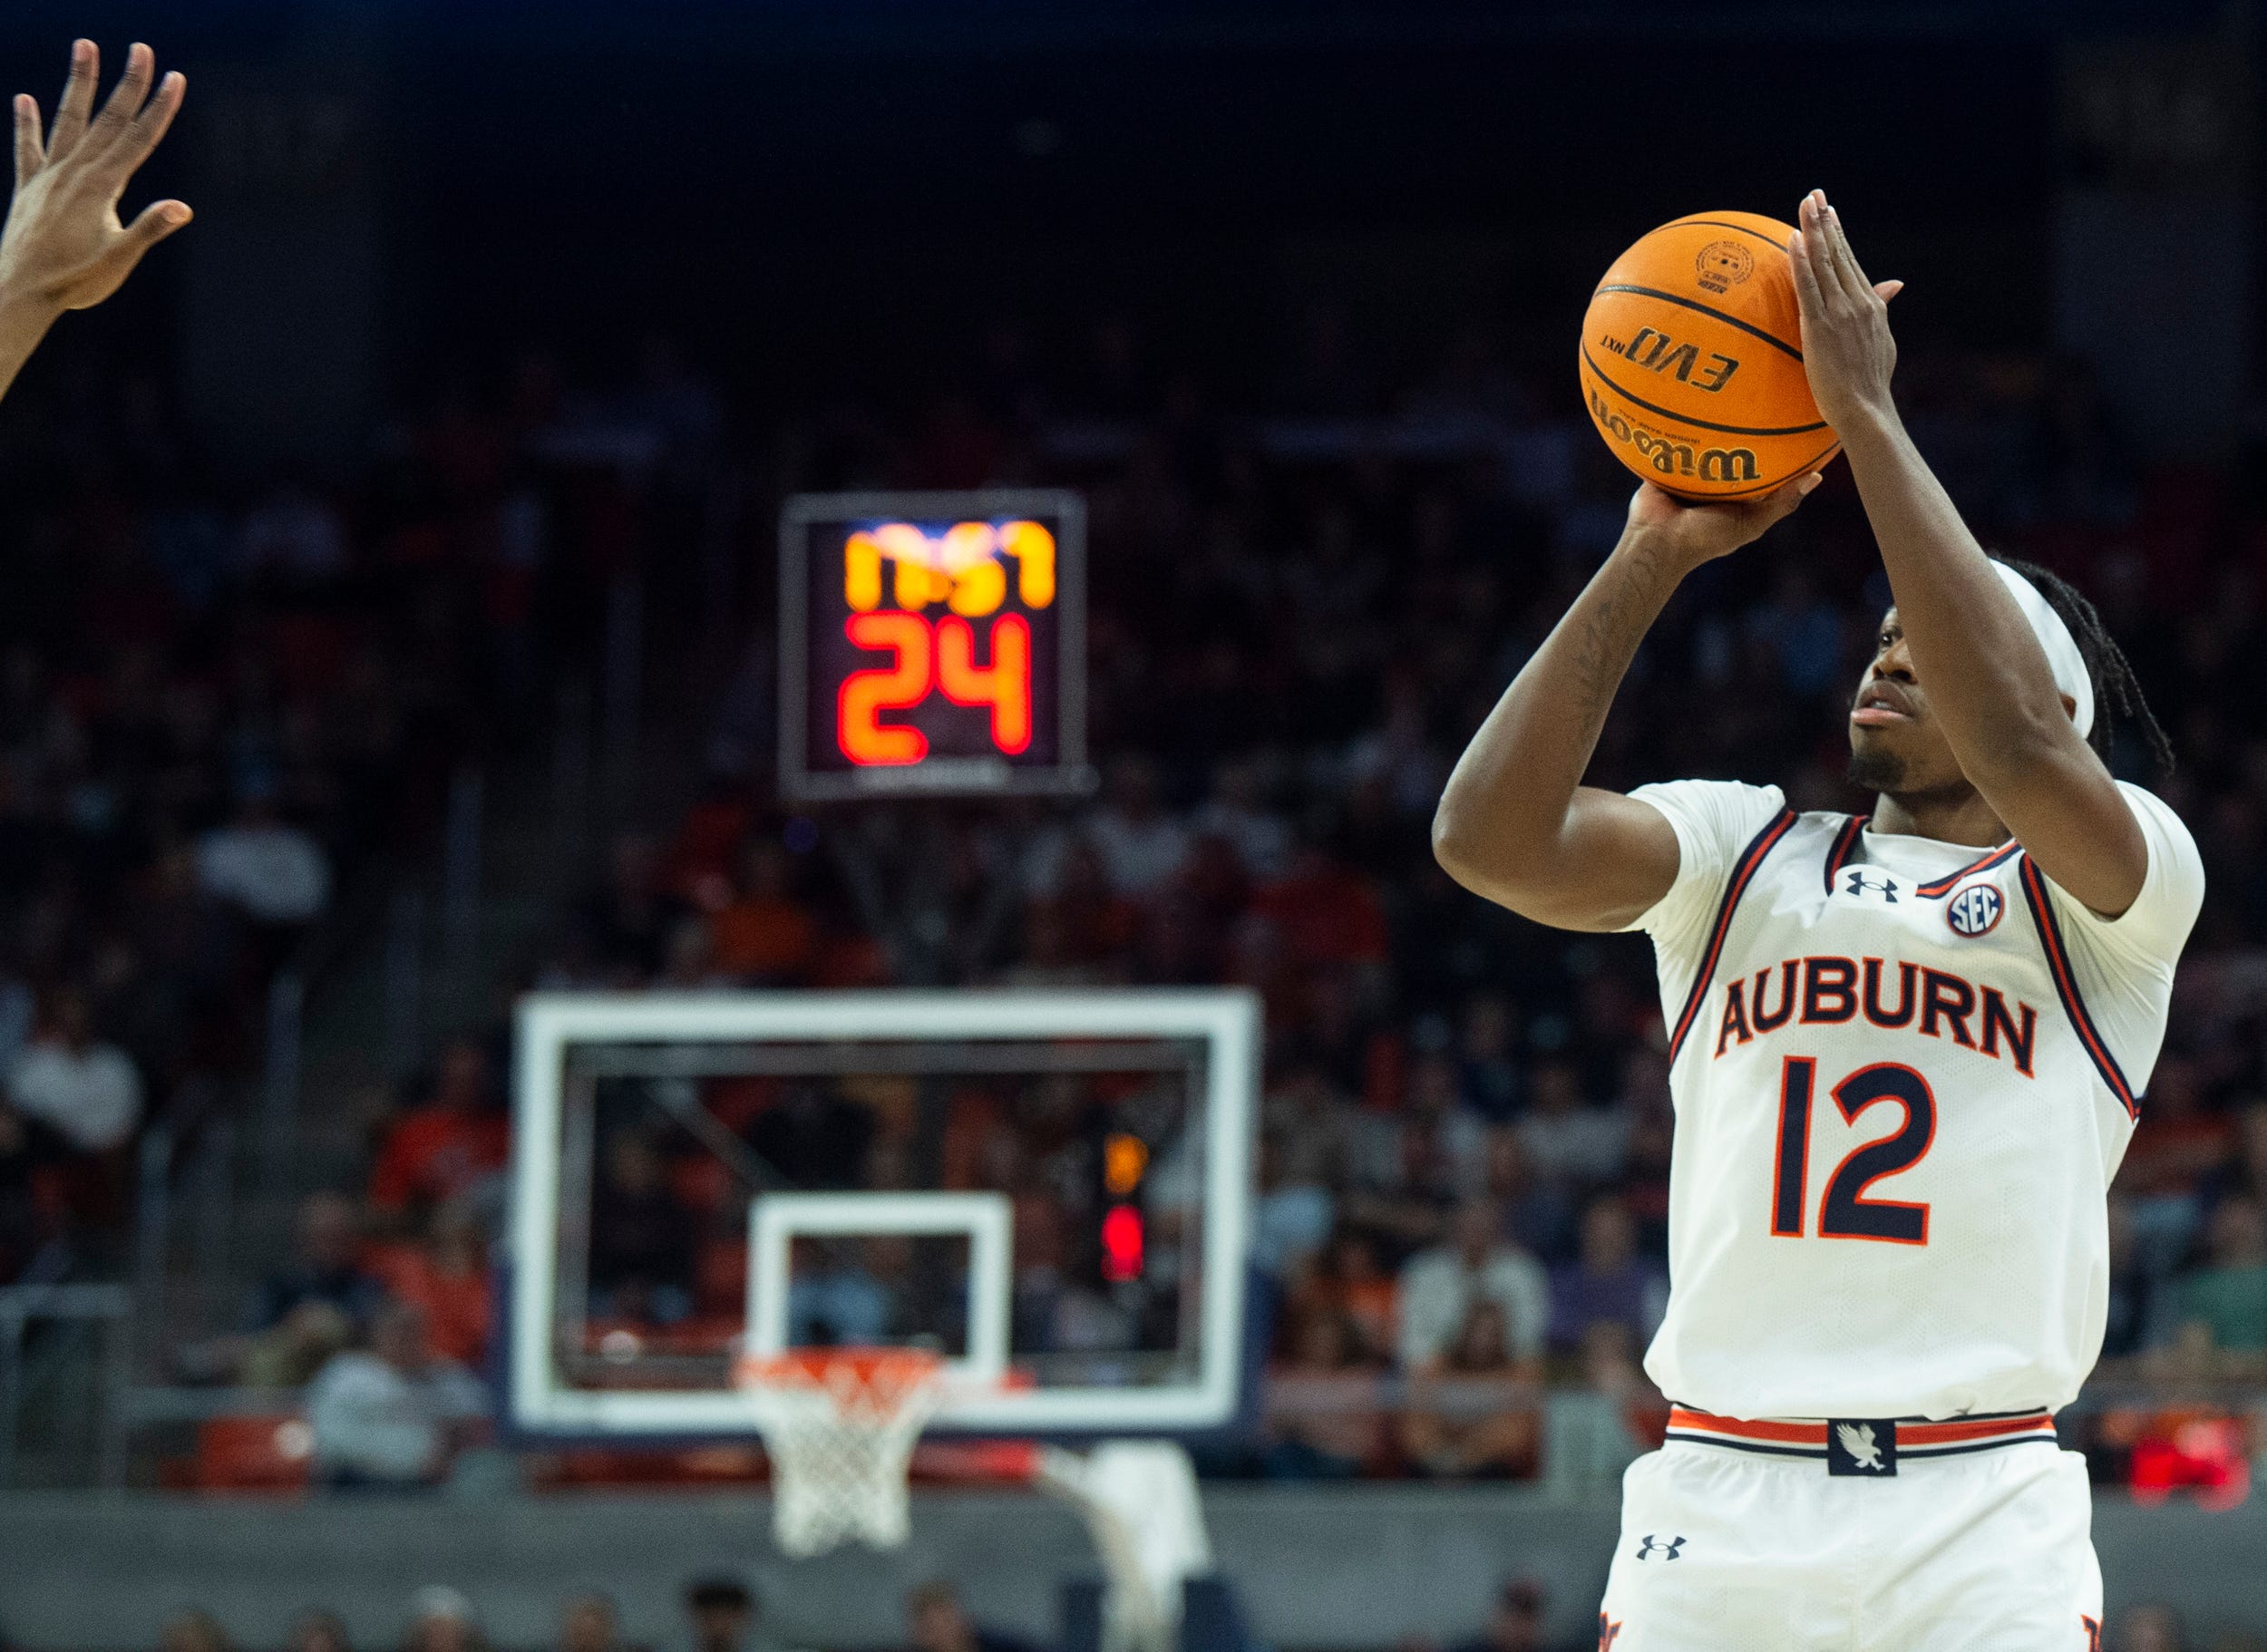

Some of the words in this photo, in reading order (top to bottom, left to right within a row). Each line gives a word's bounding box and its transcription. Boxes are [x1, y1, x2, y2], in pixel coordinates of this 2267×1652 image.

[1600, 334, 1626, 355] NXT
[1624, 326, 1739, 394] EVO
[1589, 386, 1761, 482] Wilson
[837, 609, 1032, 767] 24
[1951, 885, 1999, 934] SEC
[1713, 956, 2038, 1080] AUBURN
[1770, 1054, 1937, 1247] 12
